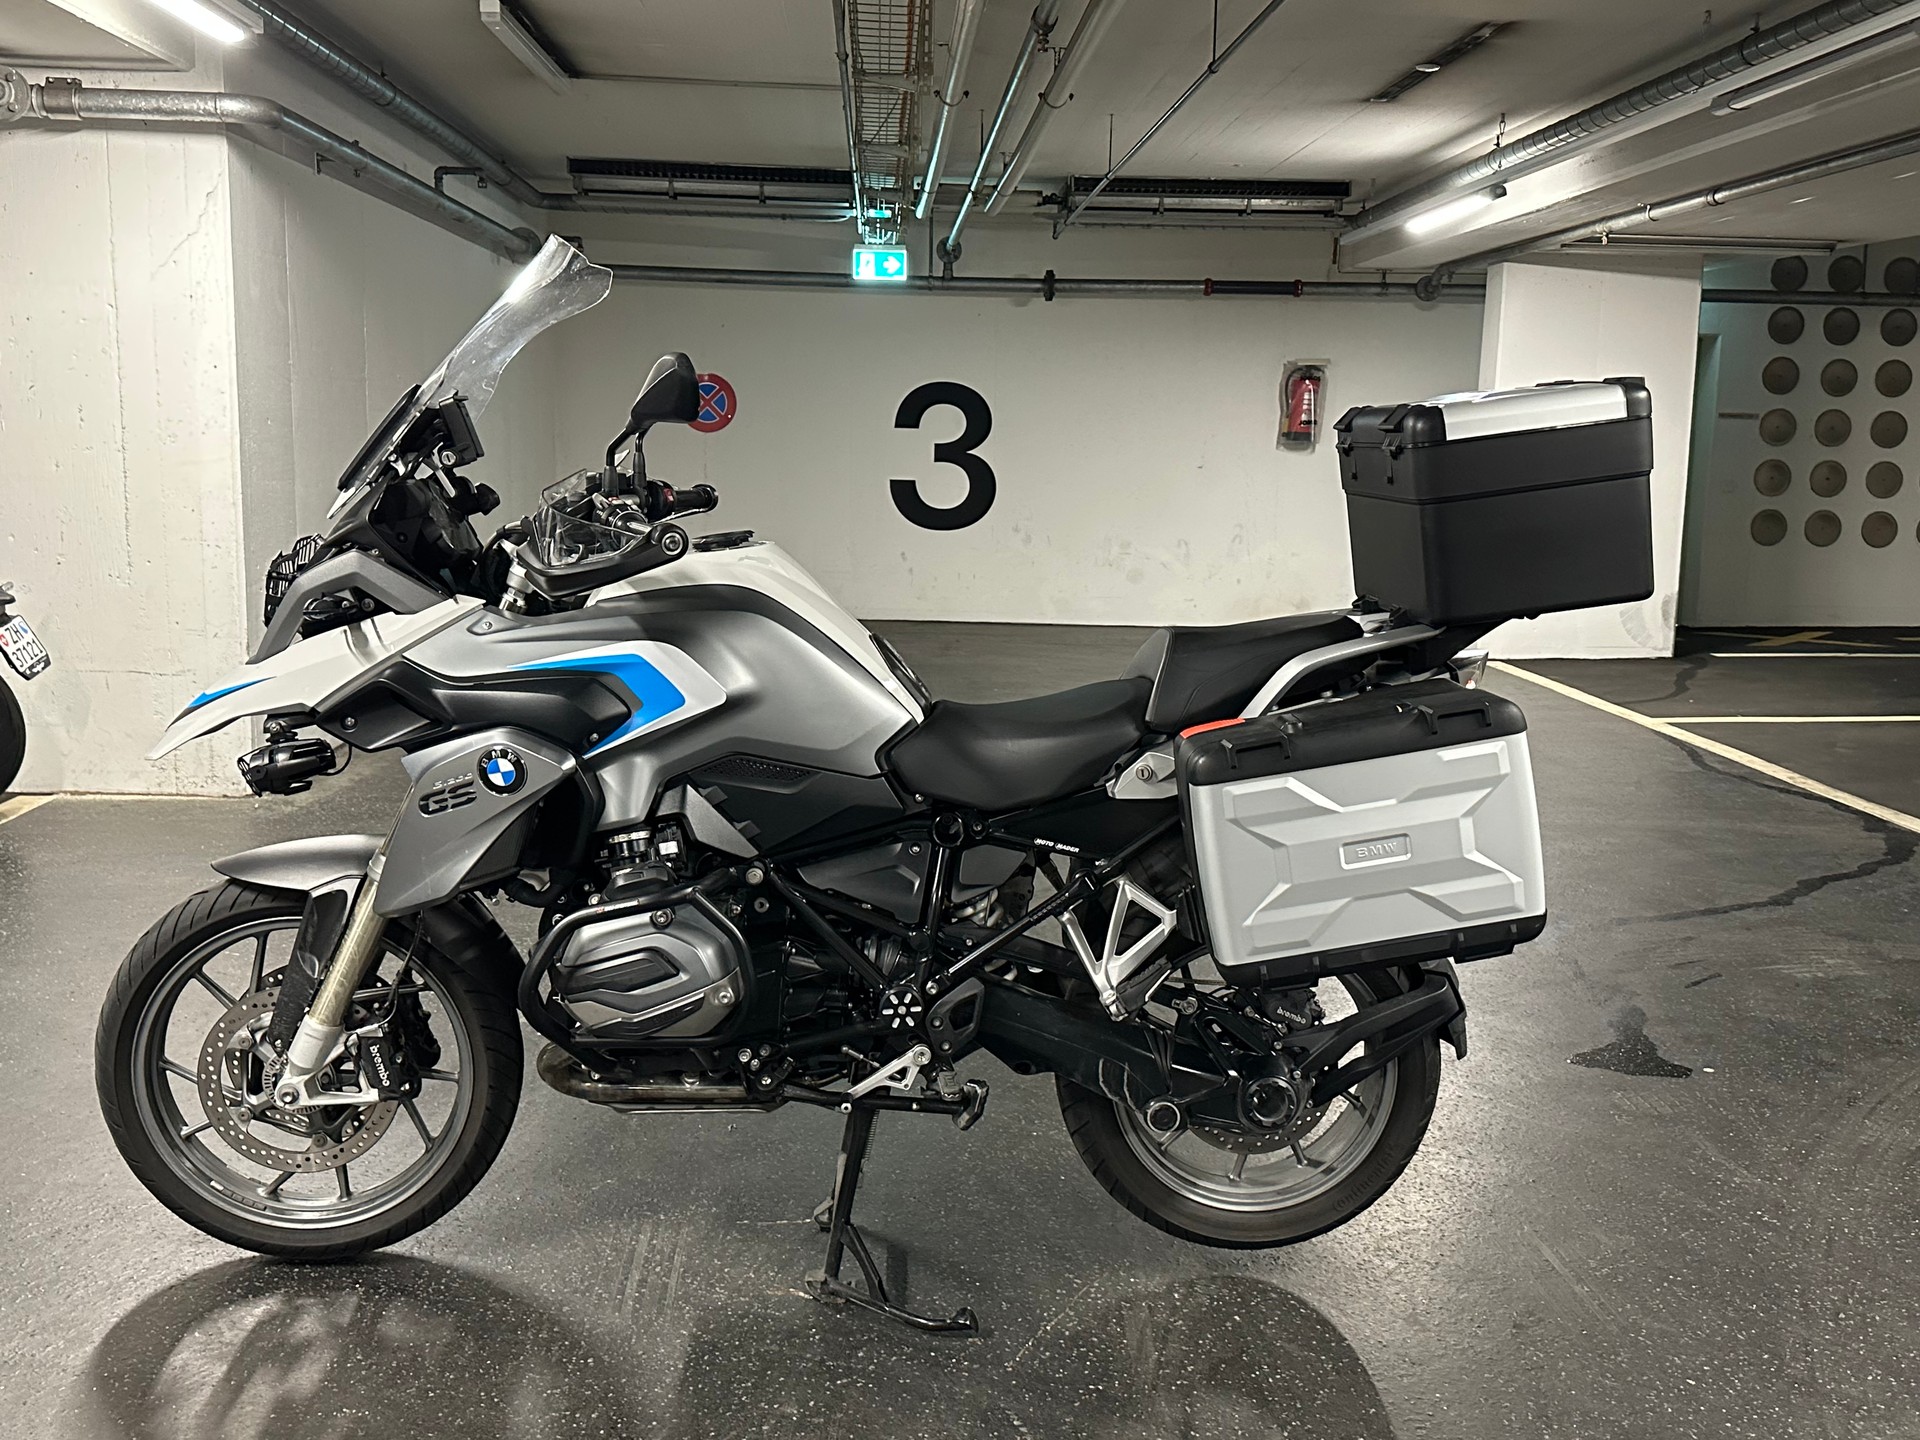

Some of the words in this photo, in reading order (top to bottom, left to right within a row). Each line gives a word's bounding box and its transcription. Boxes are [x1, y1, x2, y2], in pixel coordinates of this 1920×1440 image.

[889, 381, 997, 531] 3
[4, 623, 25, 645] ZH
[12, 638, 43, 668] 37121
[481, 750, 517, 768] BMW
[418, 780, 478, 817] GS
[1033, 838, 1055, 847] MOTO
[1054, 842, 1080, 853] MADER
[1356, 842, 1397, 858] BMW
[1276, 1006, 1306, 1025] brembo
[369, 1044, 390, 1087] brembo
